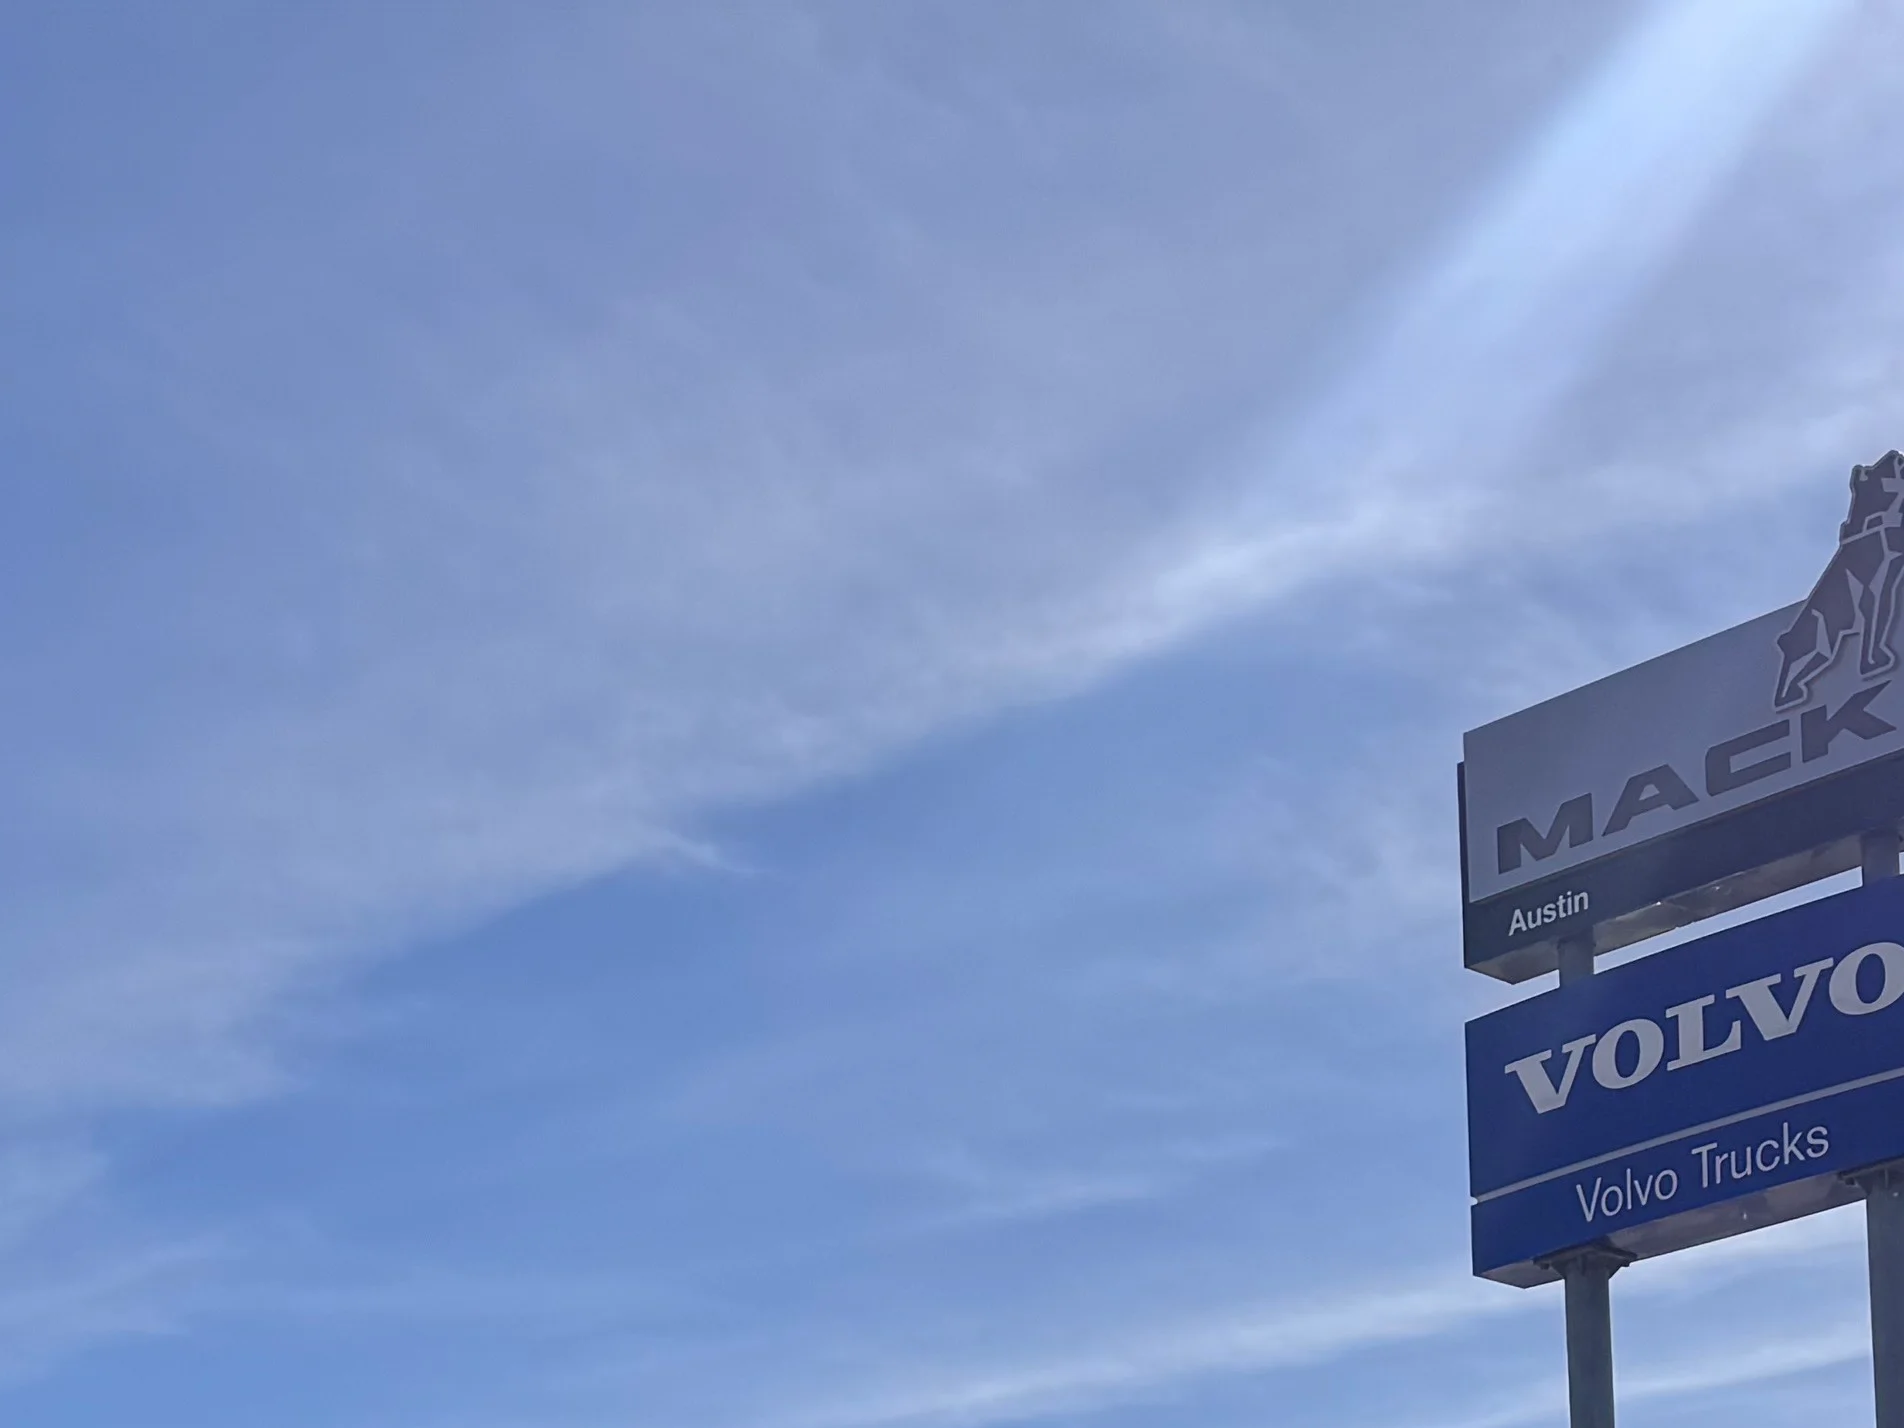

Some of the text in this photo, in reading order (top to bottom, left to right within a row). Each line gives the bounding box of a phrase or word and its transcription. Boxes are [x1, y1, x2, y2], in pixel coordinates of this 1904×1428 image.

[1497, 680, 1896, 874] MACK
[1508, 890, 1589, 936] Austin
[1575, 1121, 1830, 1223] Volvo Trucks
